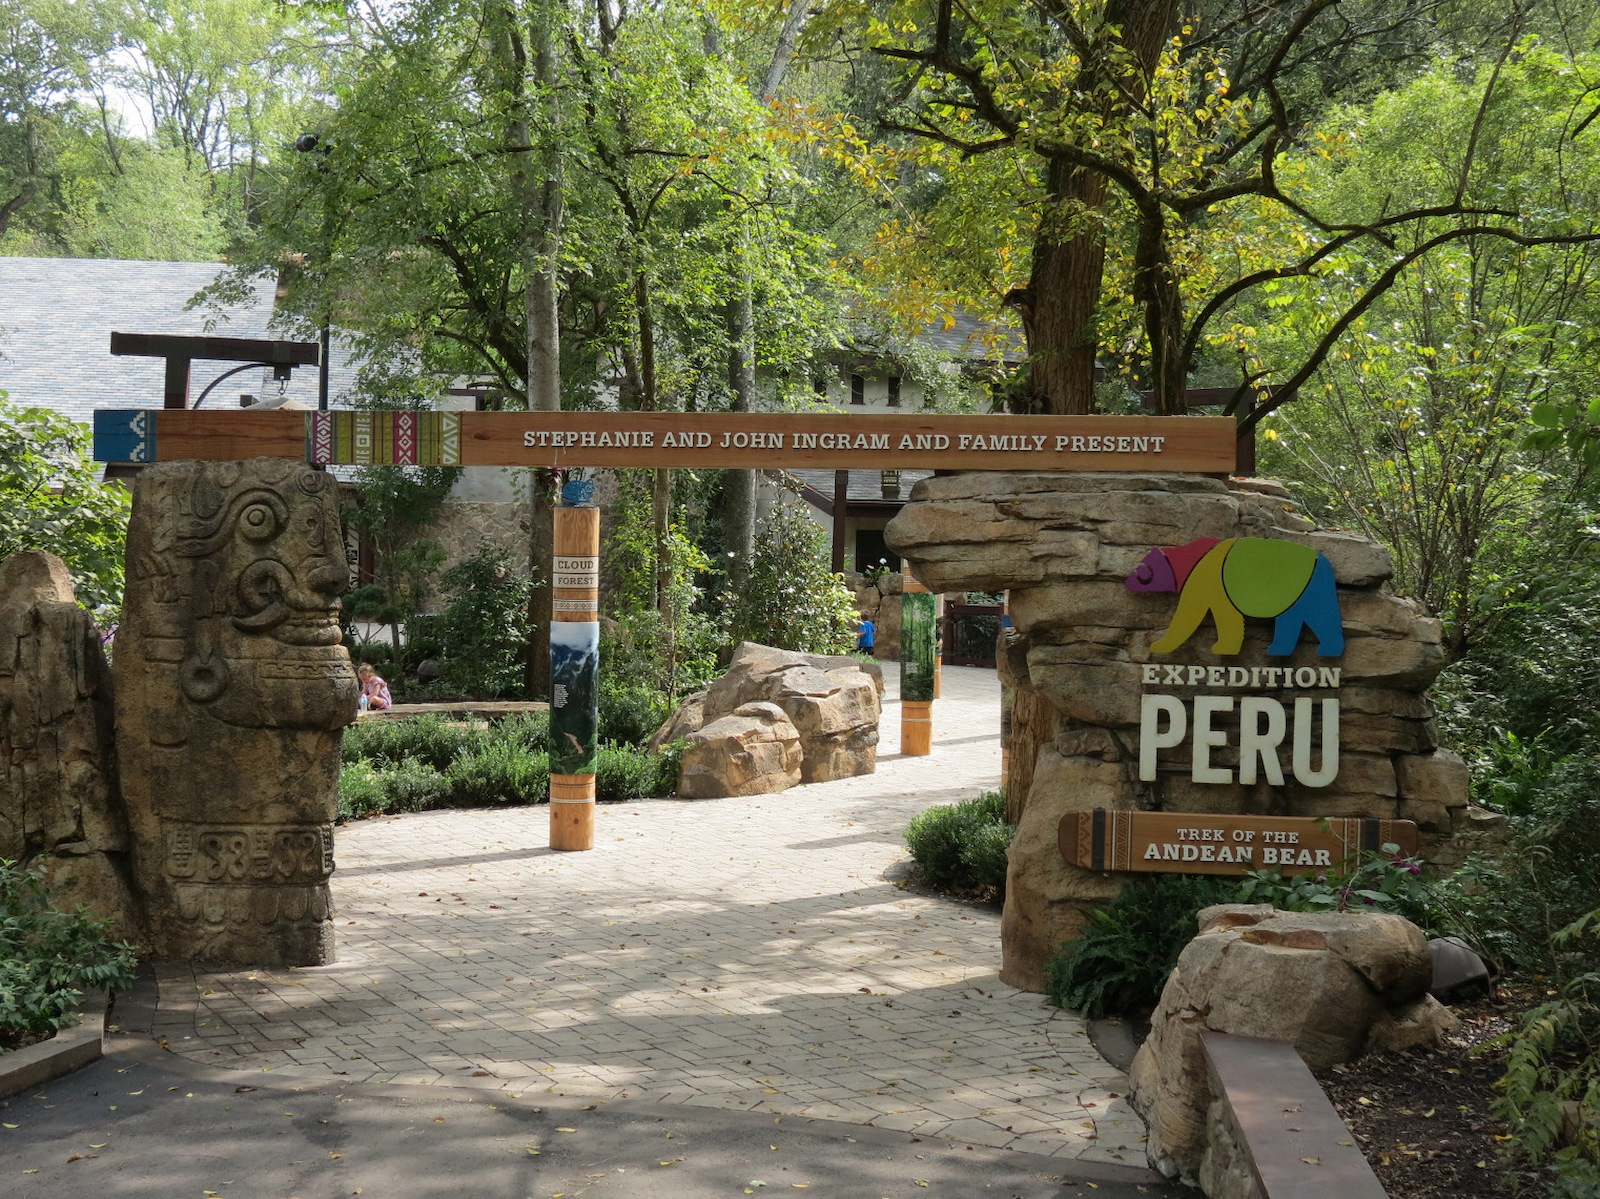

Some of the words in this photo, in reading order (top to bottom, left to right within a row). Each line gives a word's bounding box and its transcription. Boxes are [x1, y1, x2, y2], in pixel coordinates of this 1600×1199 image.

[524, 431, 654, 448] STEPHANIE
[662, 432, 712, 448] AND
[720, 432, 784, 449] JOHN
[792, 433, 890, 451] INGRAM
[899, 434, 950, 450] AND
[958, 434, 1048, 451] FAMILY
[1055, 436, 1165, 452] PRESENT
[558, 560, 594, 570] CLOUD
[558, 577, 595, 585] FOREST
[1141, 664, 1342, 688] EXPEDITION
[1139, 694, 1340, 788] PERU
[1177, 828, 1225, 842] TREK
[1232, 830, 1256, 842] OF
[1263, 831, 1299, 845] THE
[1144, 843, 1254, 863] ANDEAN
[1262, 847, 1332, 866] BEAR
